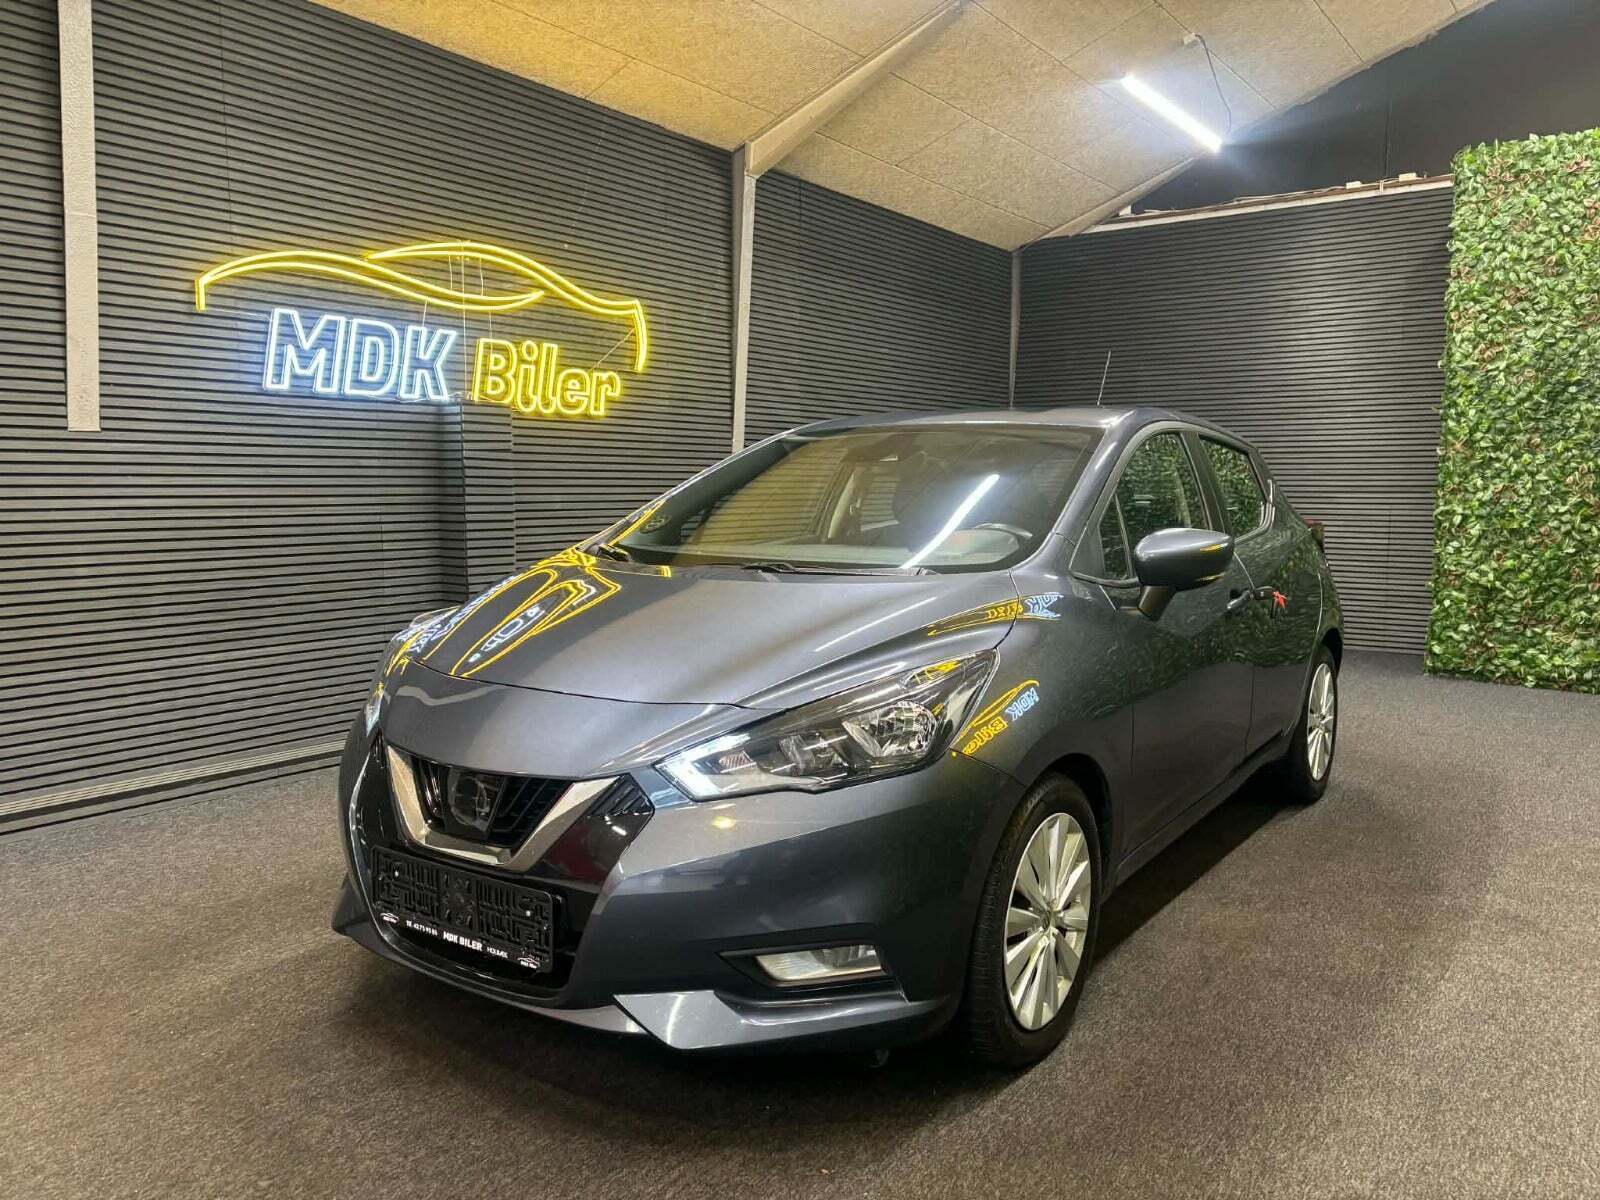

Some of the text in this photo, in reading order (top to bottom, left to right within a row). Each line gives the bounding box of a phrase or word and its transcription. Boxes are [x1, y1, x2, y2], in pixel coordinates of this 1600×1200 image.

[263, 307, 622, 417] MDK Biler
[443, 931, 459, 944] MDK
[460, 936, 483, 952] BILER
